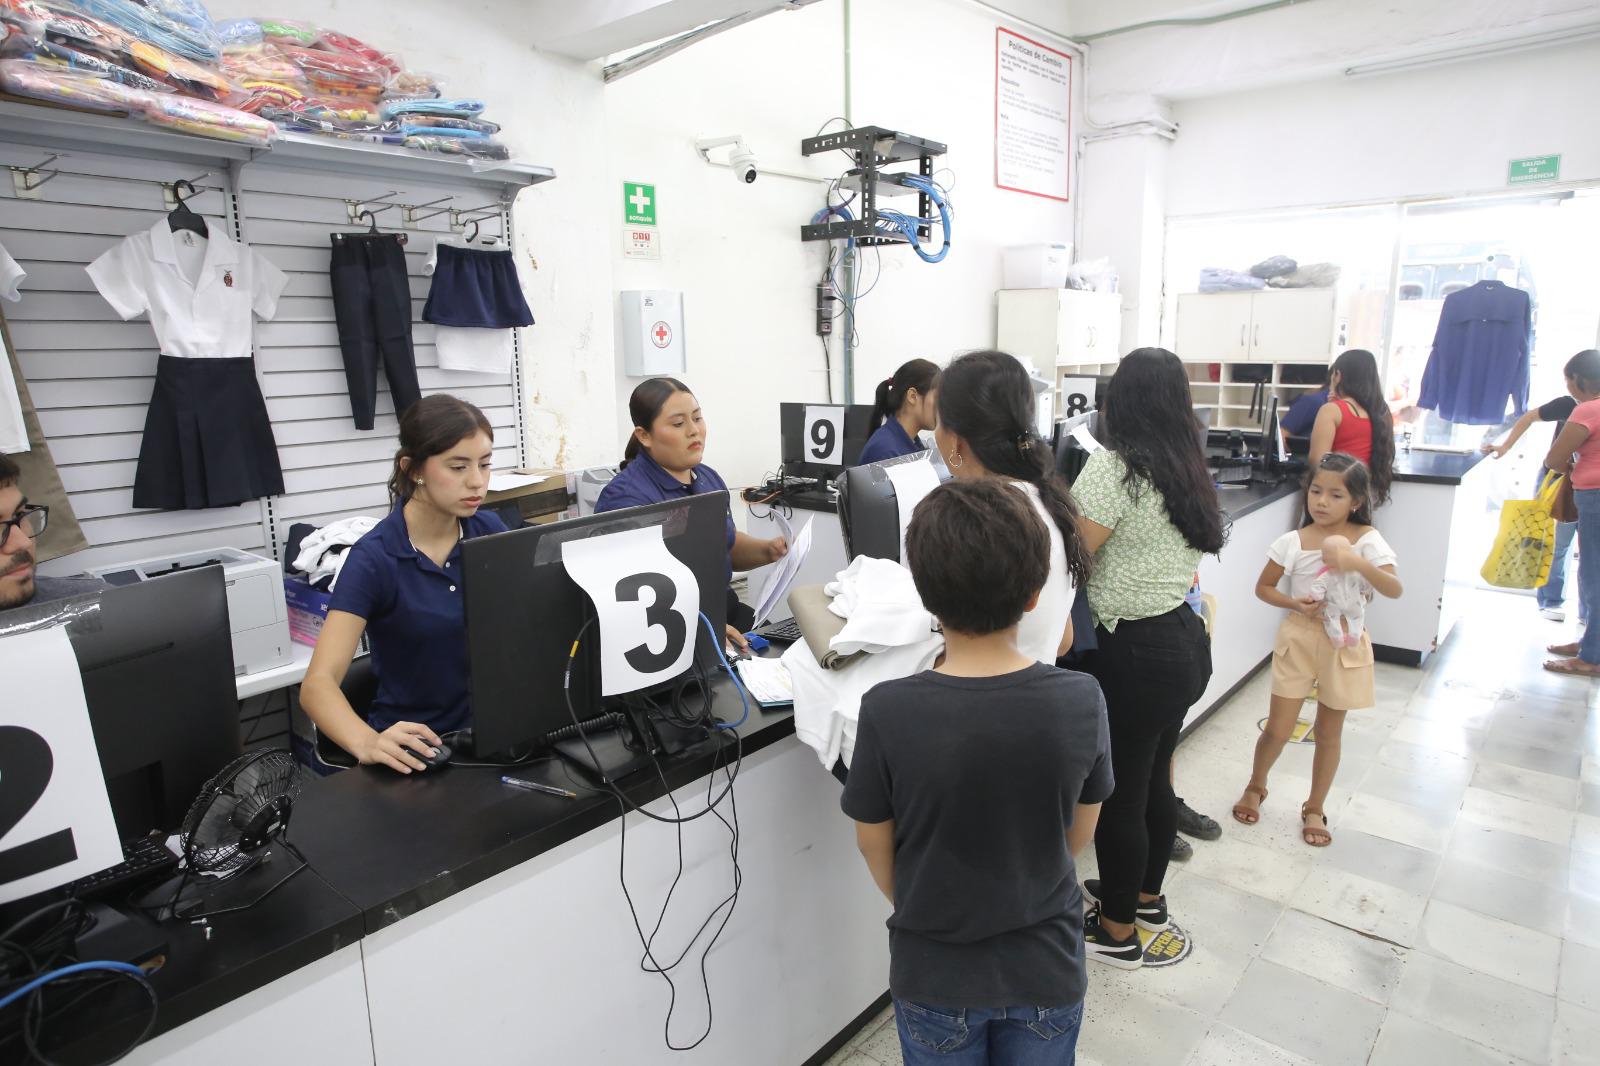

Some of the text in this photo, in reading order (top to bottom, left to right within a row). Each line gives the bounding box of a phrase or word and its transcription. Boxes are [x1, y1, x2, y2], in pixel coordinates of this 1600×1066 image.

[1067, 393, 1087, 418] 8
[811, 419, 835, 459] 9
[615, 572, 686, 673] 3
[1148, 931, 1174, 956] ESPERA
